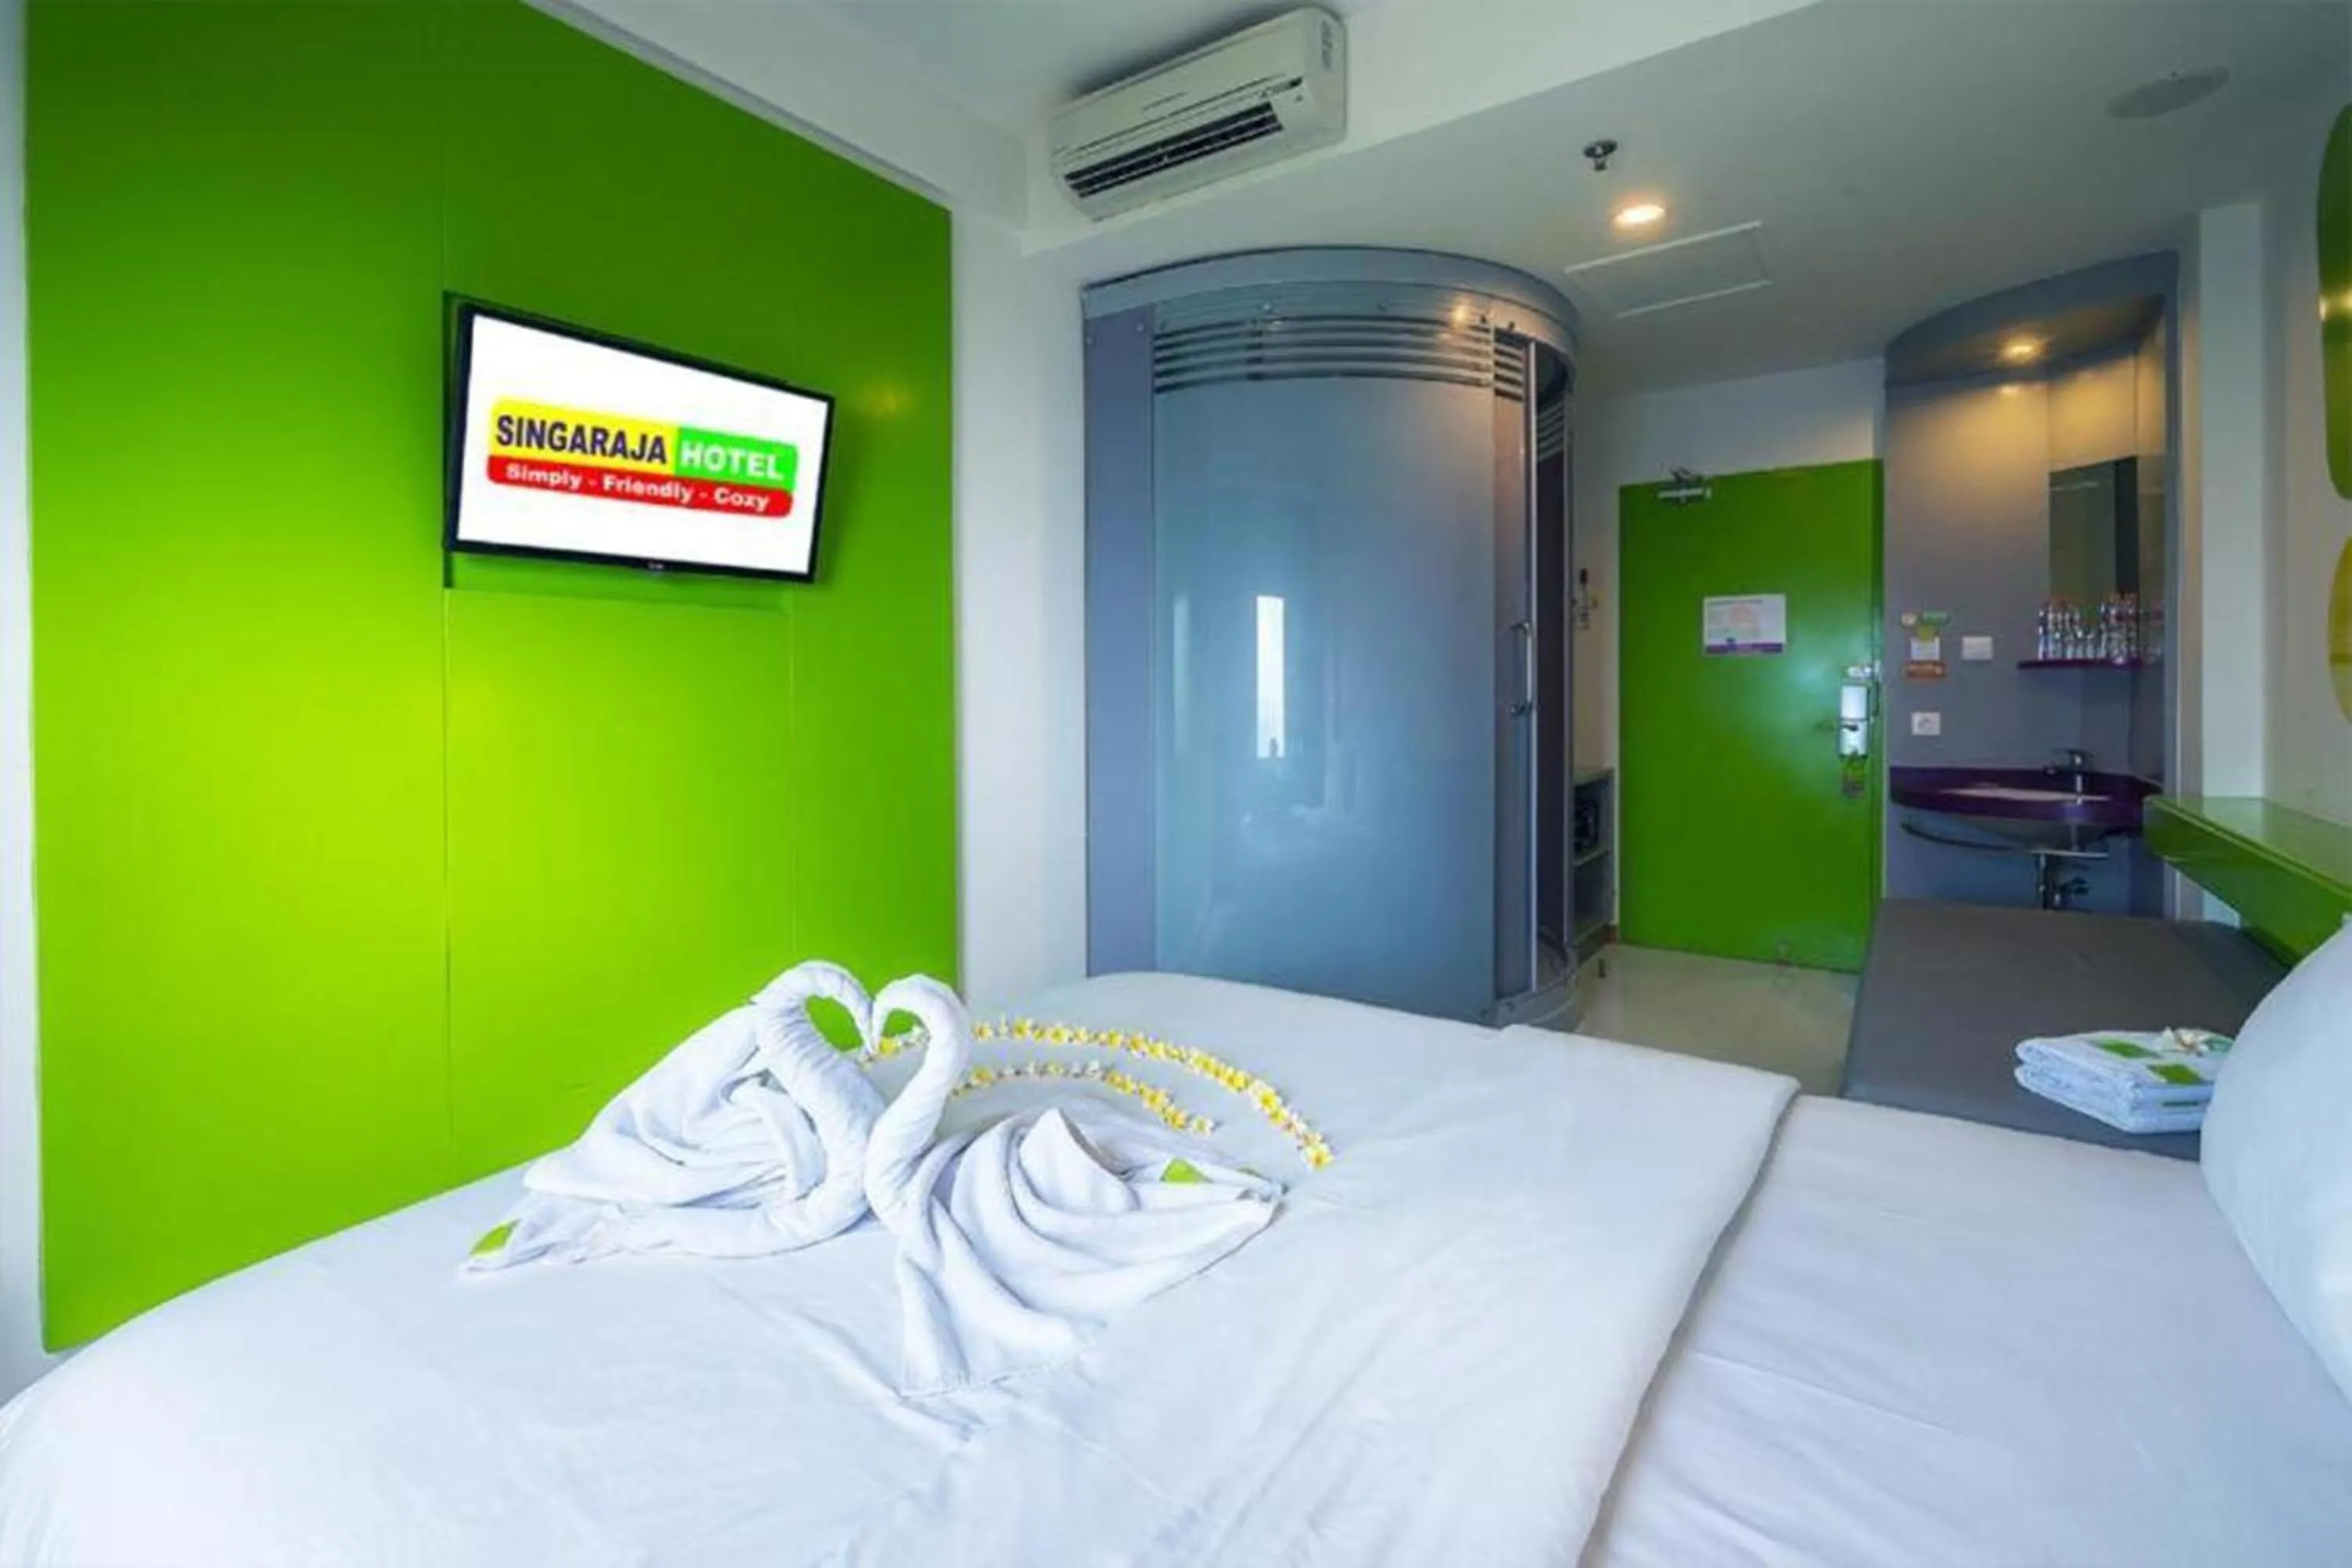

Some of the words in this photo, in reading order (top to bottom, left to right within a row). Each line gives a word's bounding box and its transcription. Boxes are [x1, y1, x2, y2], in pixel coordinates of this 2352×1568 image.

[496, 415, 666, 464] SINGARAJA
[681, 441, 784, 480] HOTEL
[506, 463, 583, 490] Simply
[602, 474, 693, 503] Friendly
